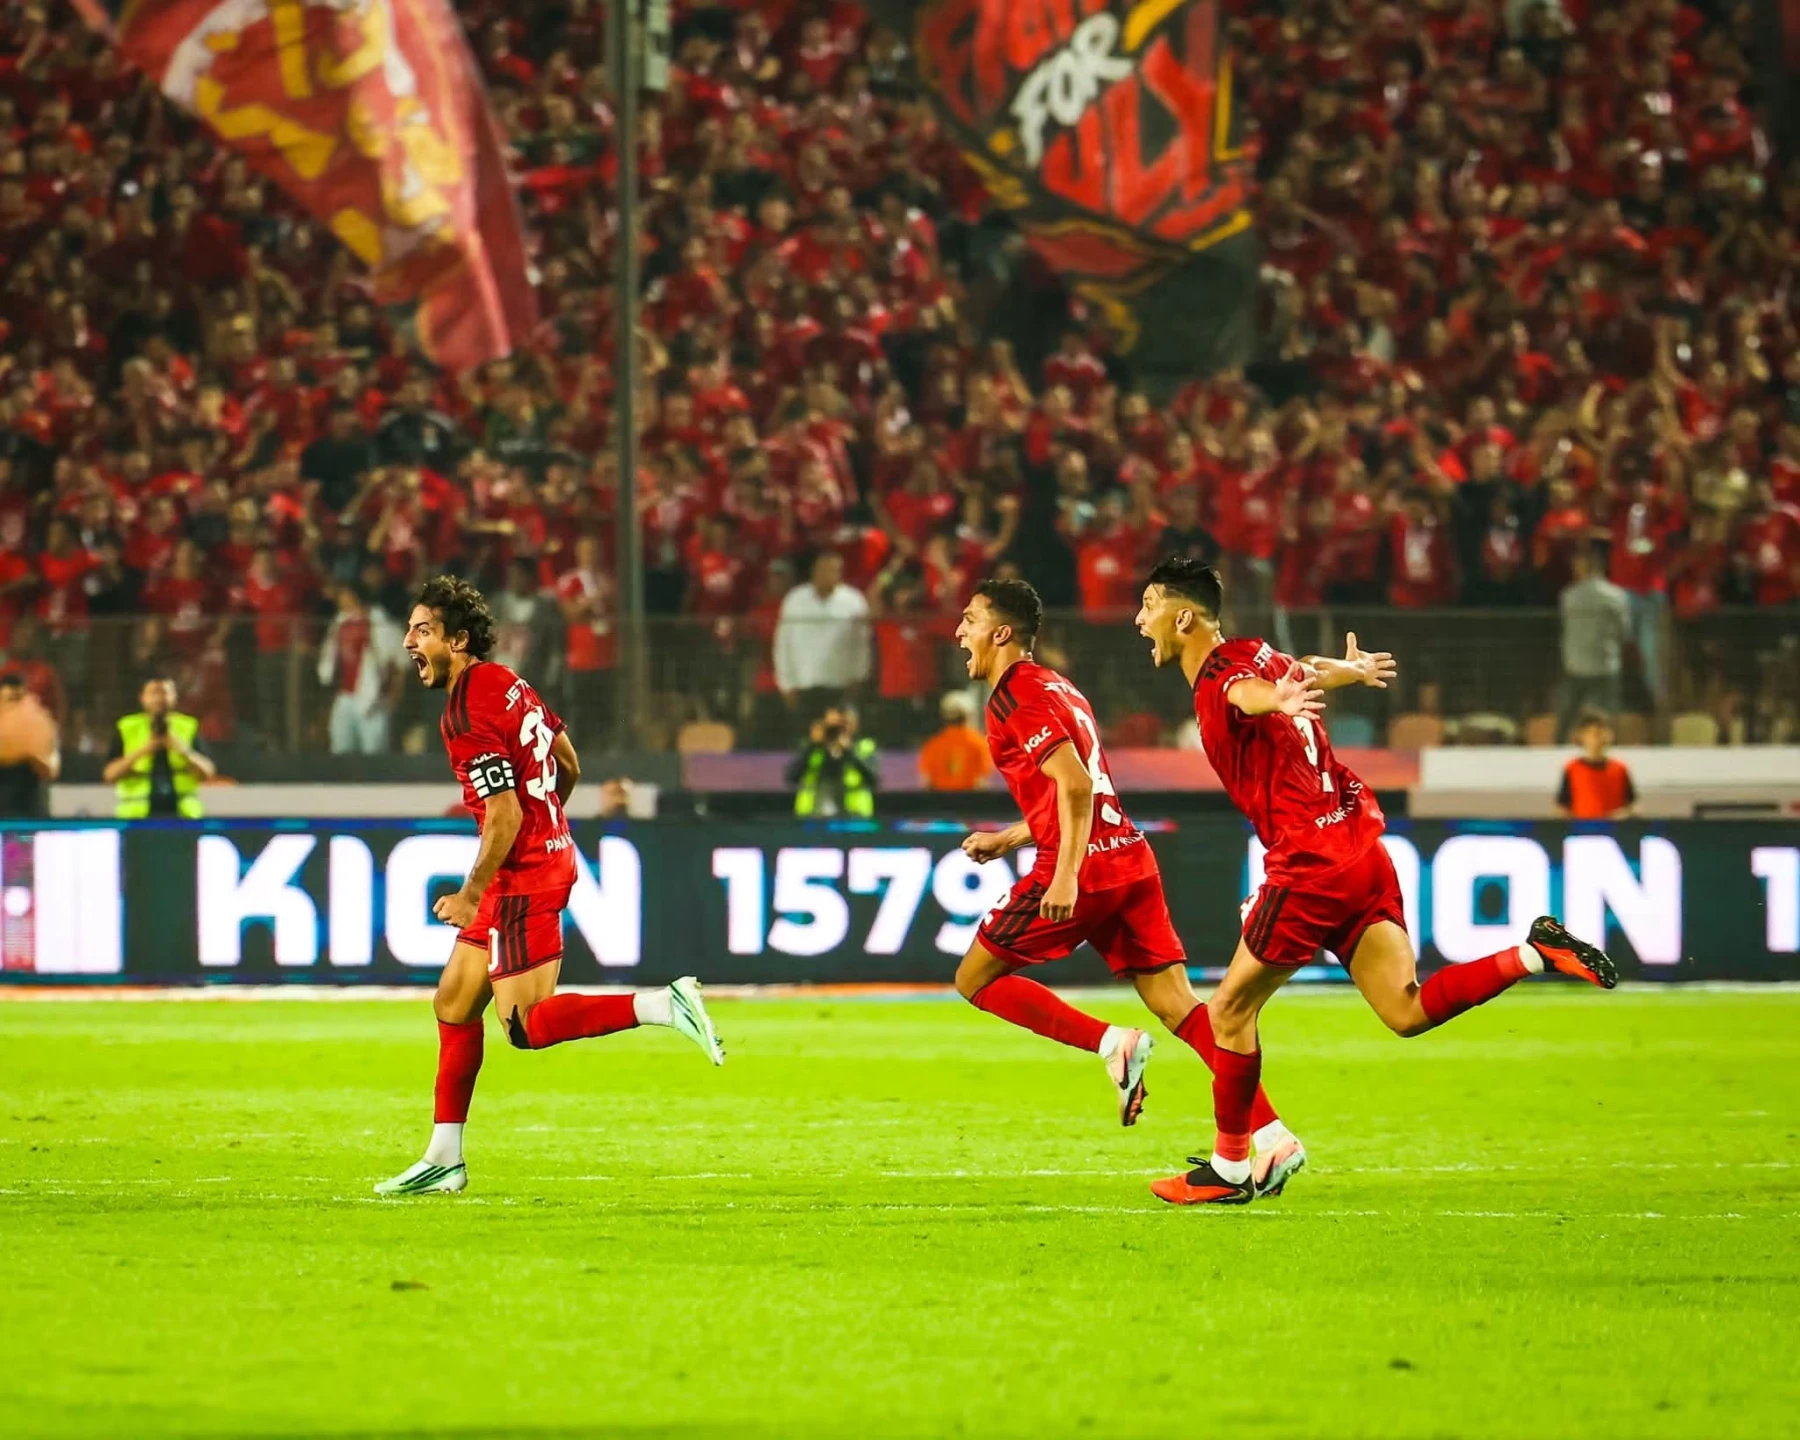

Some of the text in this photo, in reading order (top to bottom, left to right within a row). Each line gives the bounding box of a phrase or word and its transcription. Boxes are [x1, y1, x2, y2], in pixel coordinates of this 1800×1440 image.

[1010, 11, 1133, 168] FOR
[485, 765, 505, 788] C
[197, 833, 641, 967] KION
[712, 846, 1038, 958] 1579
